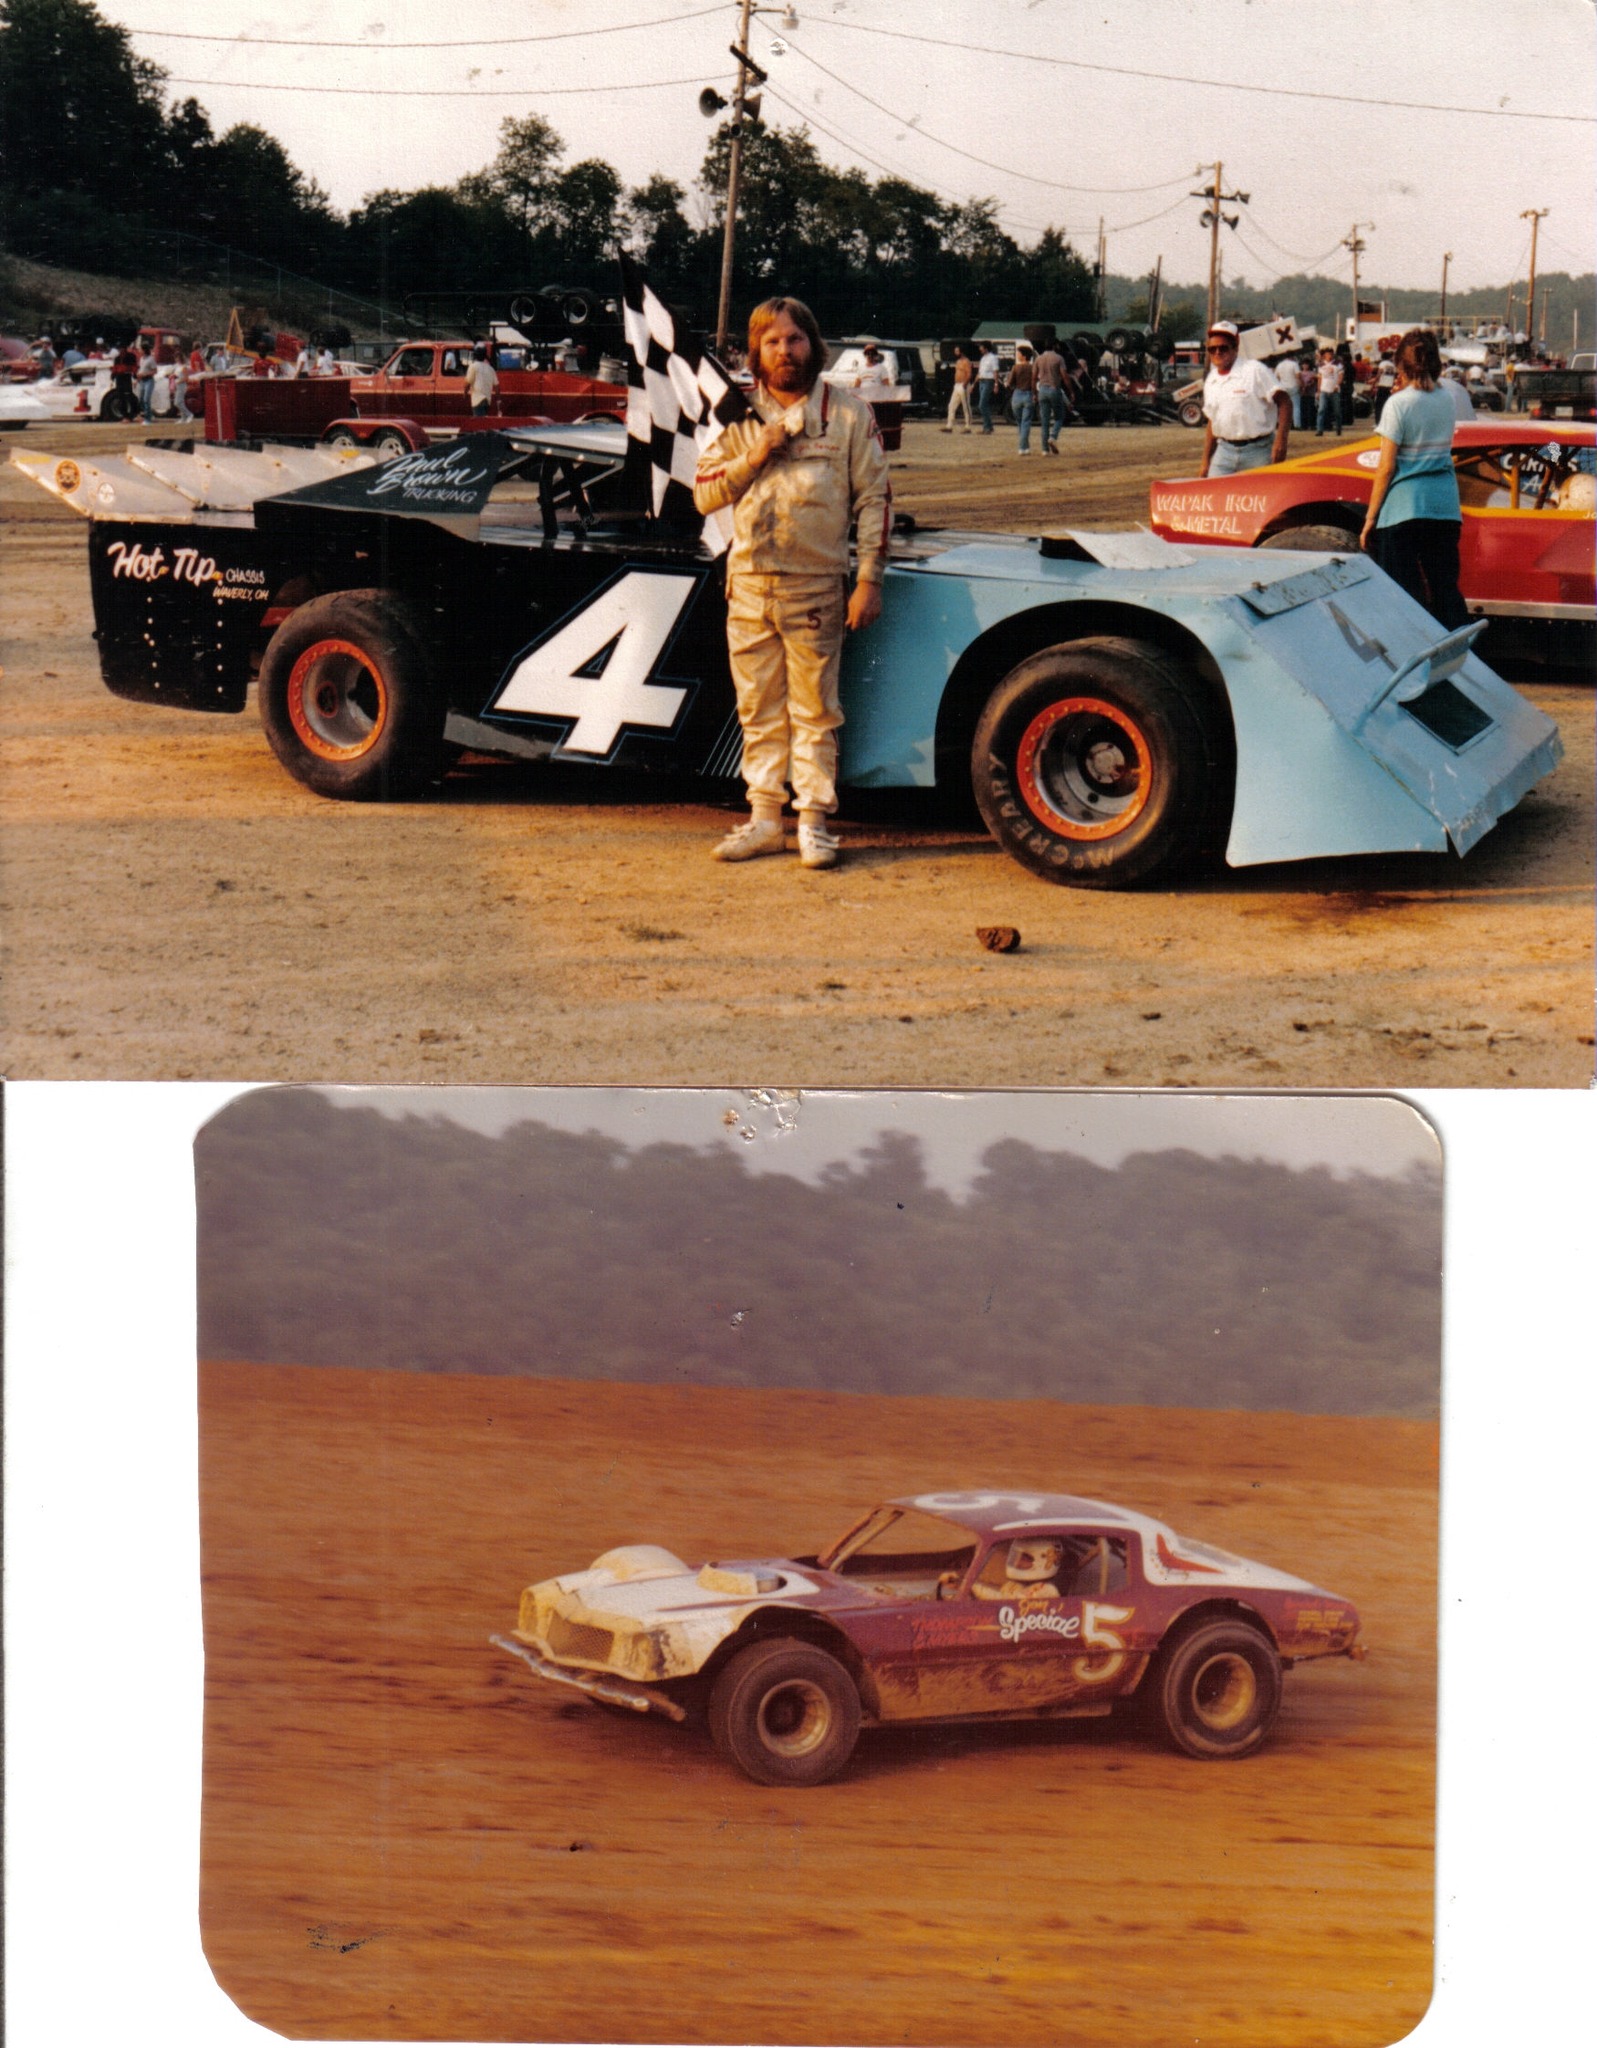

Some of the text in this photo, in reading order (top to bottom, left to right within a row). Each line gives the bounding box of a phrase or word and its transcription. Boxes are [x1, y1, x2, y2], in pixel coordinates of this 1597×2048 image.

[366, 468, 488, 494] Brown
[402, 487, 478, 503] TRUCKING
[1156, 494, 1267, 513] WAPAK IRON
[107, 541, 164, 579] Hot
[226, 567, 265, 584] CHASSIS
[494, 571, 697, 754] 4
[999, 1600, 1135, 1684] Special 5
